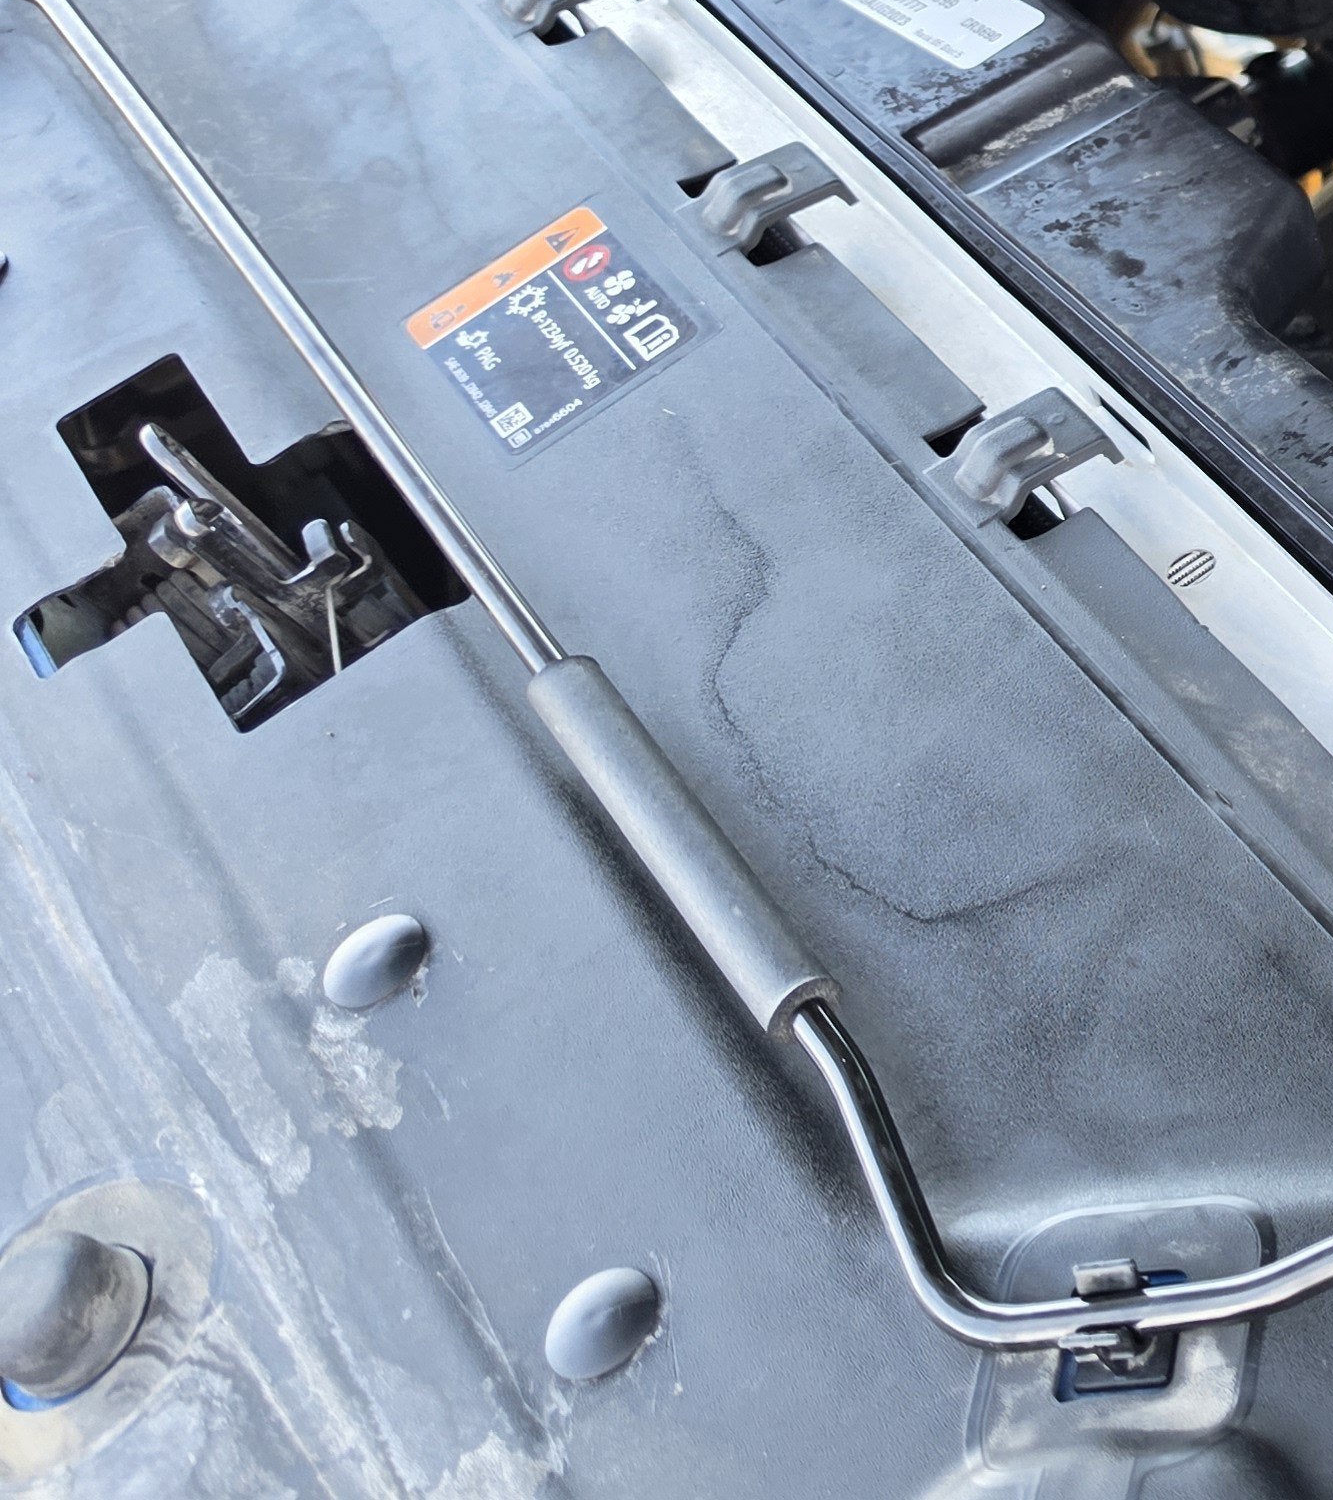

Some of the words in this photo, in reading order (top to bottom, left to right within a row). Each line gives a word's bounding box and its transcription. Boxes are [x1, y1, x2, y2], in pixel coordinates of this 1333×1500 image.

[584, 285, 612, 310] AUTO
[474, 345, 502, 371] PAG
[531, 309, 575, 351] R-1234yf
[582, 368, 602, 390] kg
